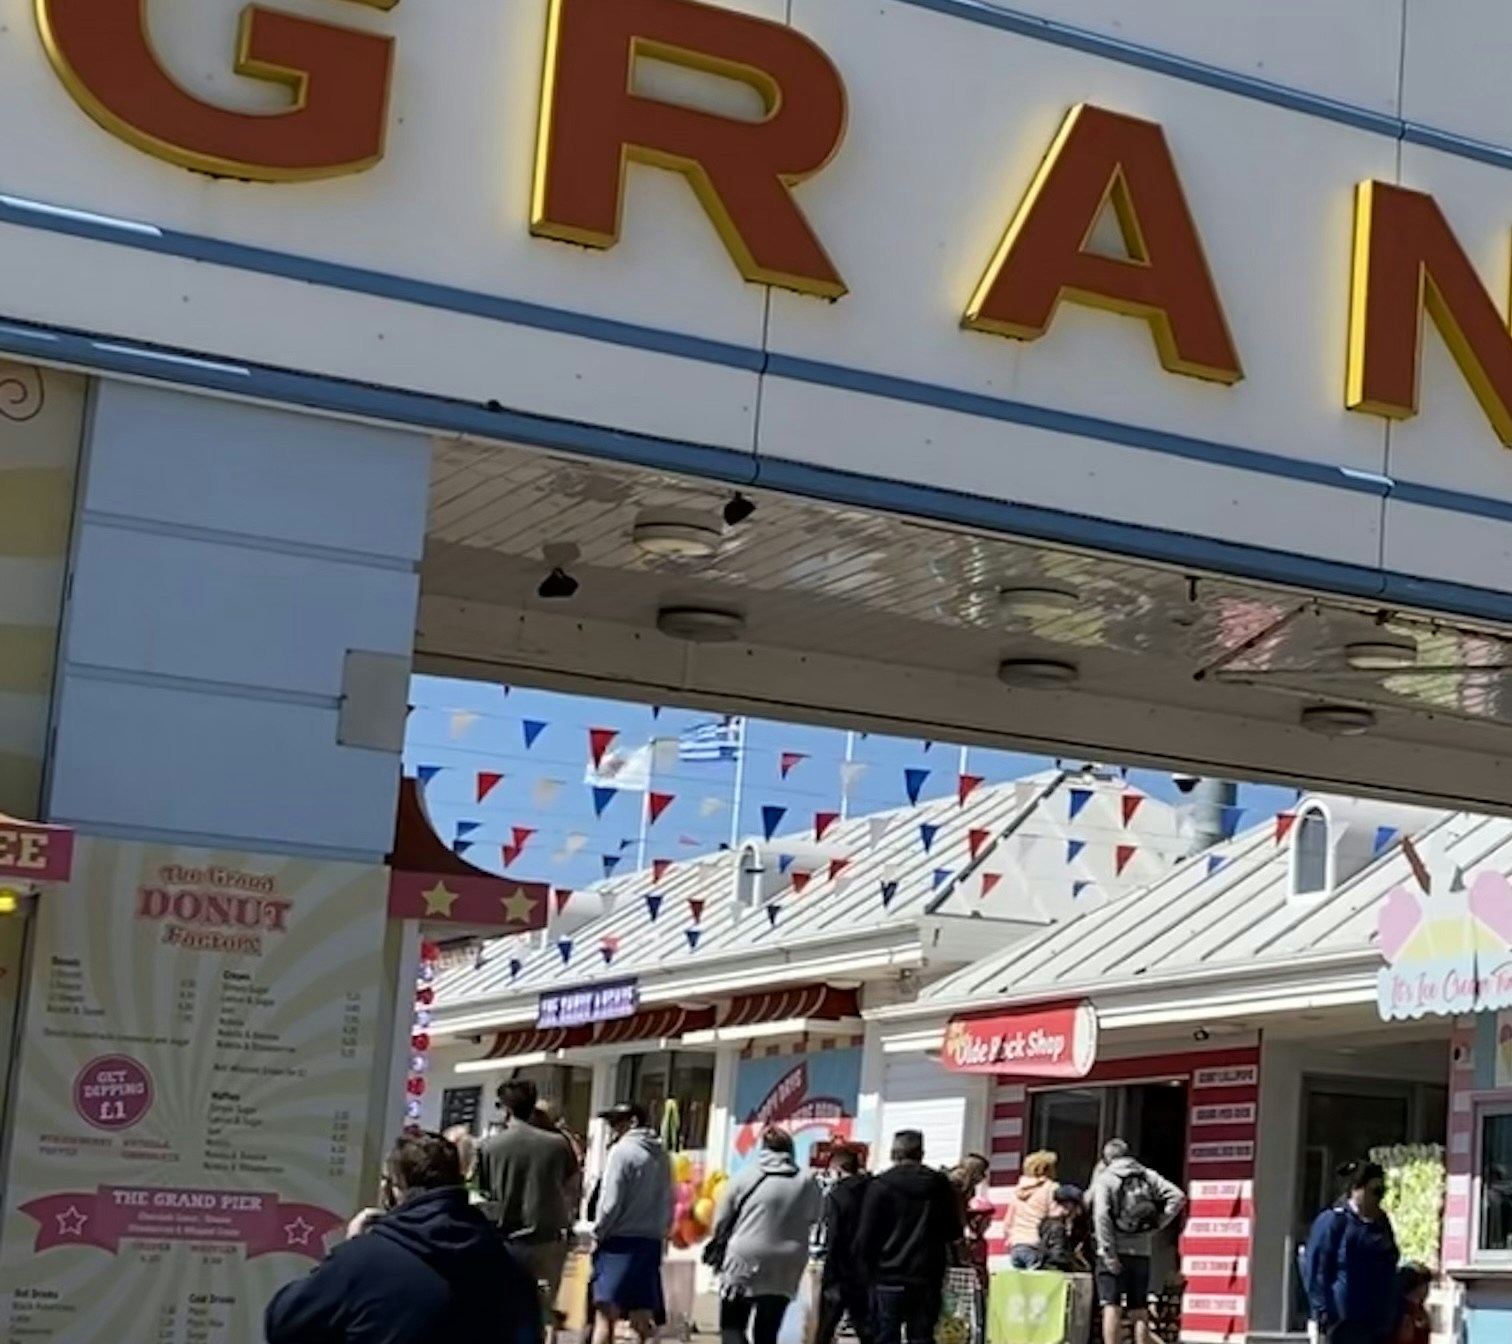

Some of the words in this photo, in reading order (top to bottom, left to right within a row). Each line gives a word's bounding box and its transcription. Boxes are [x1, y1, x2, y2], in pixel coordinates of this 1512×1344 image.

[160, 864, 200, 883] The
[138, 886, 292, 931] DONUT
[1416, 971, 1437, 1007] Ice
[1028, 1028, 1064, 1063] Shop
[97, 1069, 128, 1083] GET
[84, 1082, 144, 1098] DIPPING
[100, 1101, 126, 1119] £1
[113, 1191, 148, 1205] THE
[154, 1192, 216, 1208] GRAND
[221, 1196, 262, 1210] PIER
